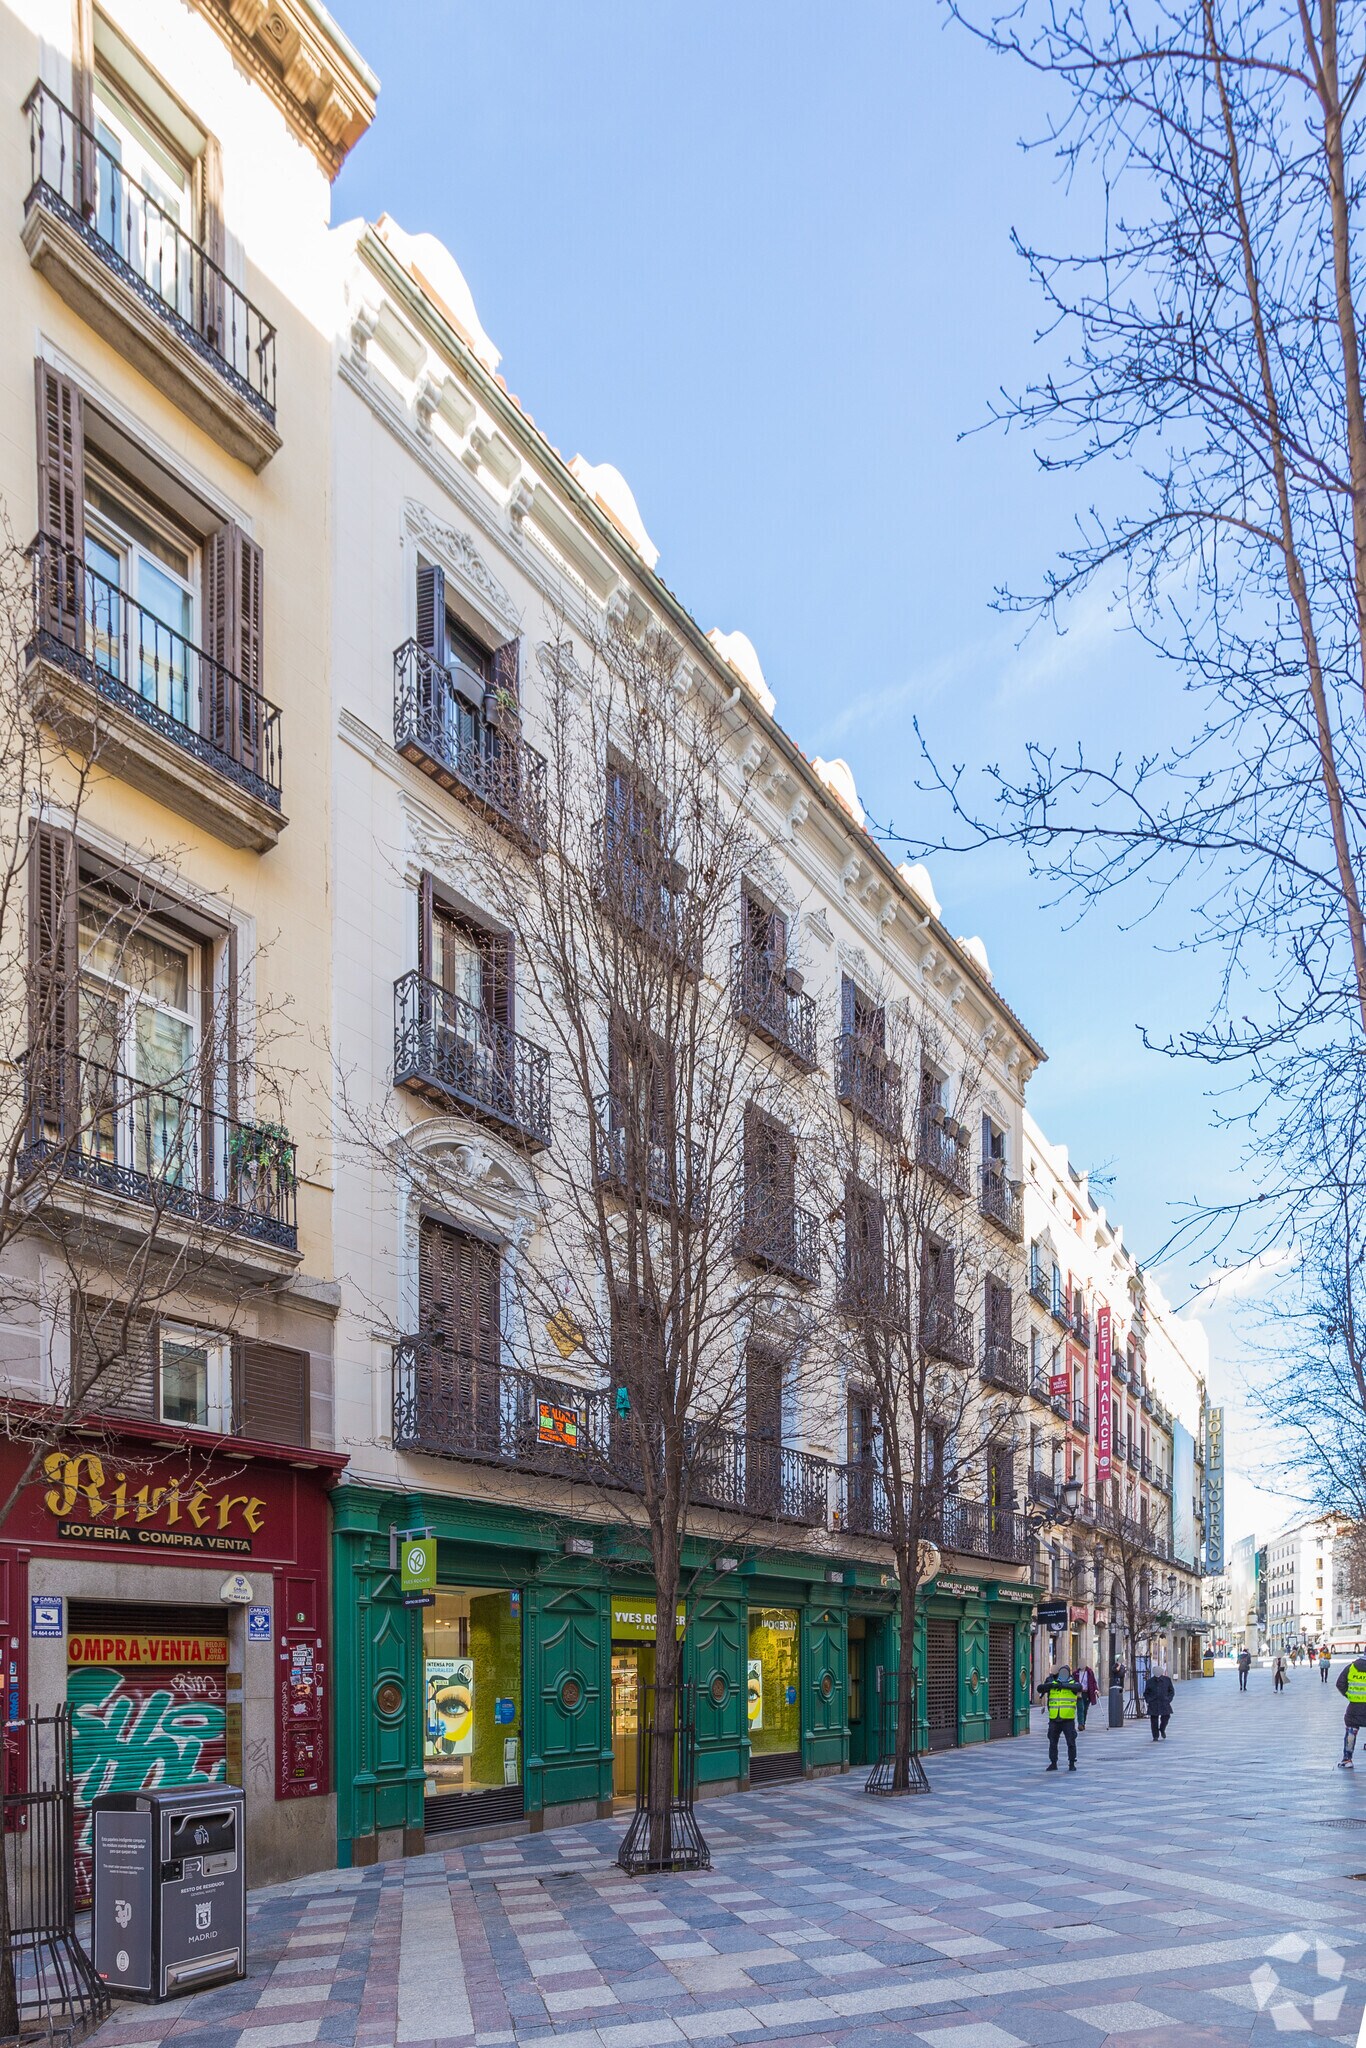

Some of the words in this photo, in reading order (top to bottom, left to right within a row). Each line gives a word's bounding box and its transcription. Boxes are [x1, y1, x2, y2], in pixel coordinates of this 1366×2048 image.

[1101, 1380, 1109, 1450] PALACE
[1208, 1410, 1221, 1470] HOTEL
[1207, 1477, 1222, 1562] MODERNO
[61, 1524, 130, 1541] JOYERÍA
[139, 1532, 204, 1547] COMPRA
[207, 1538, 251, 1551] VENTA
[937, 1581, 962, 1589] CAROLINA
[963, 1584, 979, 1592] LEMKE
[999, 1589, 1020, 1597] CAROLINA
[615, 1612, 641, 1623] YVES
[644, 1614, 685, 1625] ROER
[69, 1638, 141, 1661] OMPRA
[148, 1639, 201, 1661] VENTA
[203, 1881, 224, 1889] RESIDUOS
[188, 1931, 217, 1943] MADRID
